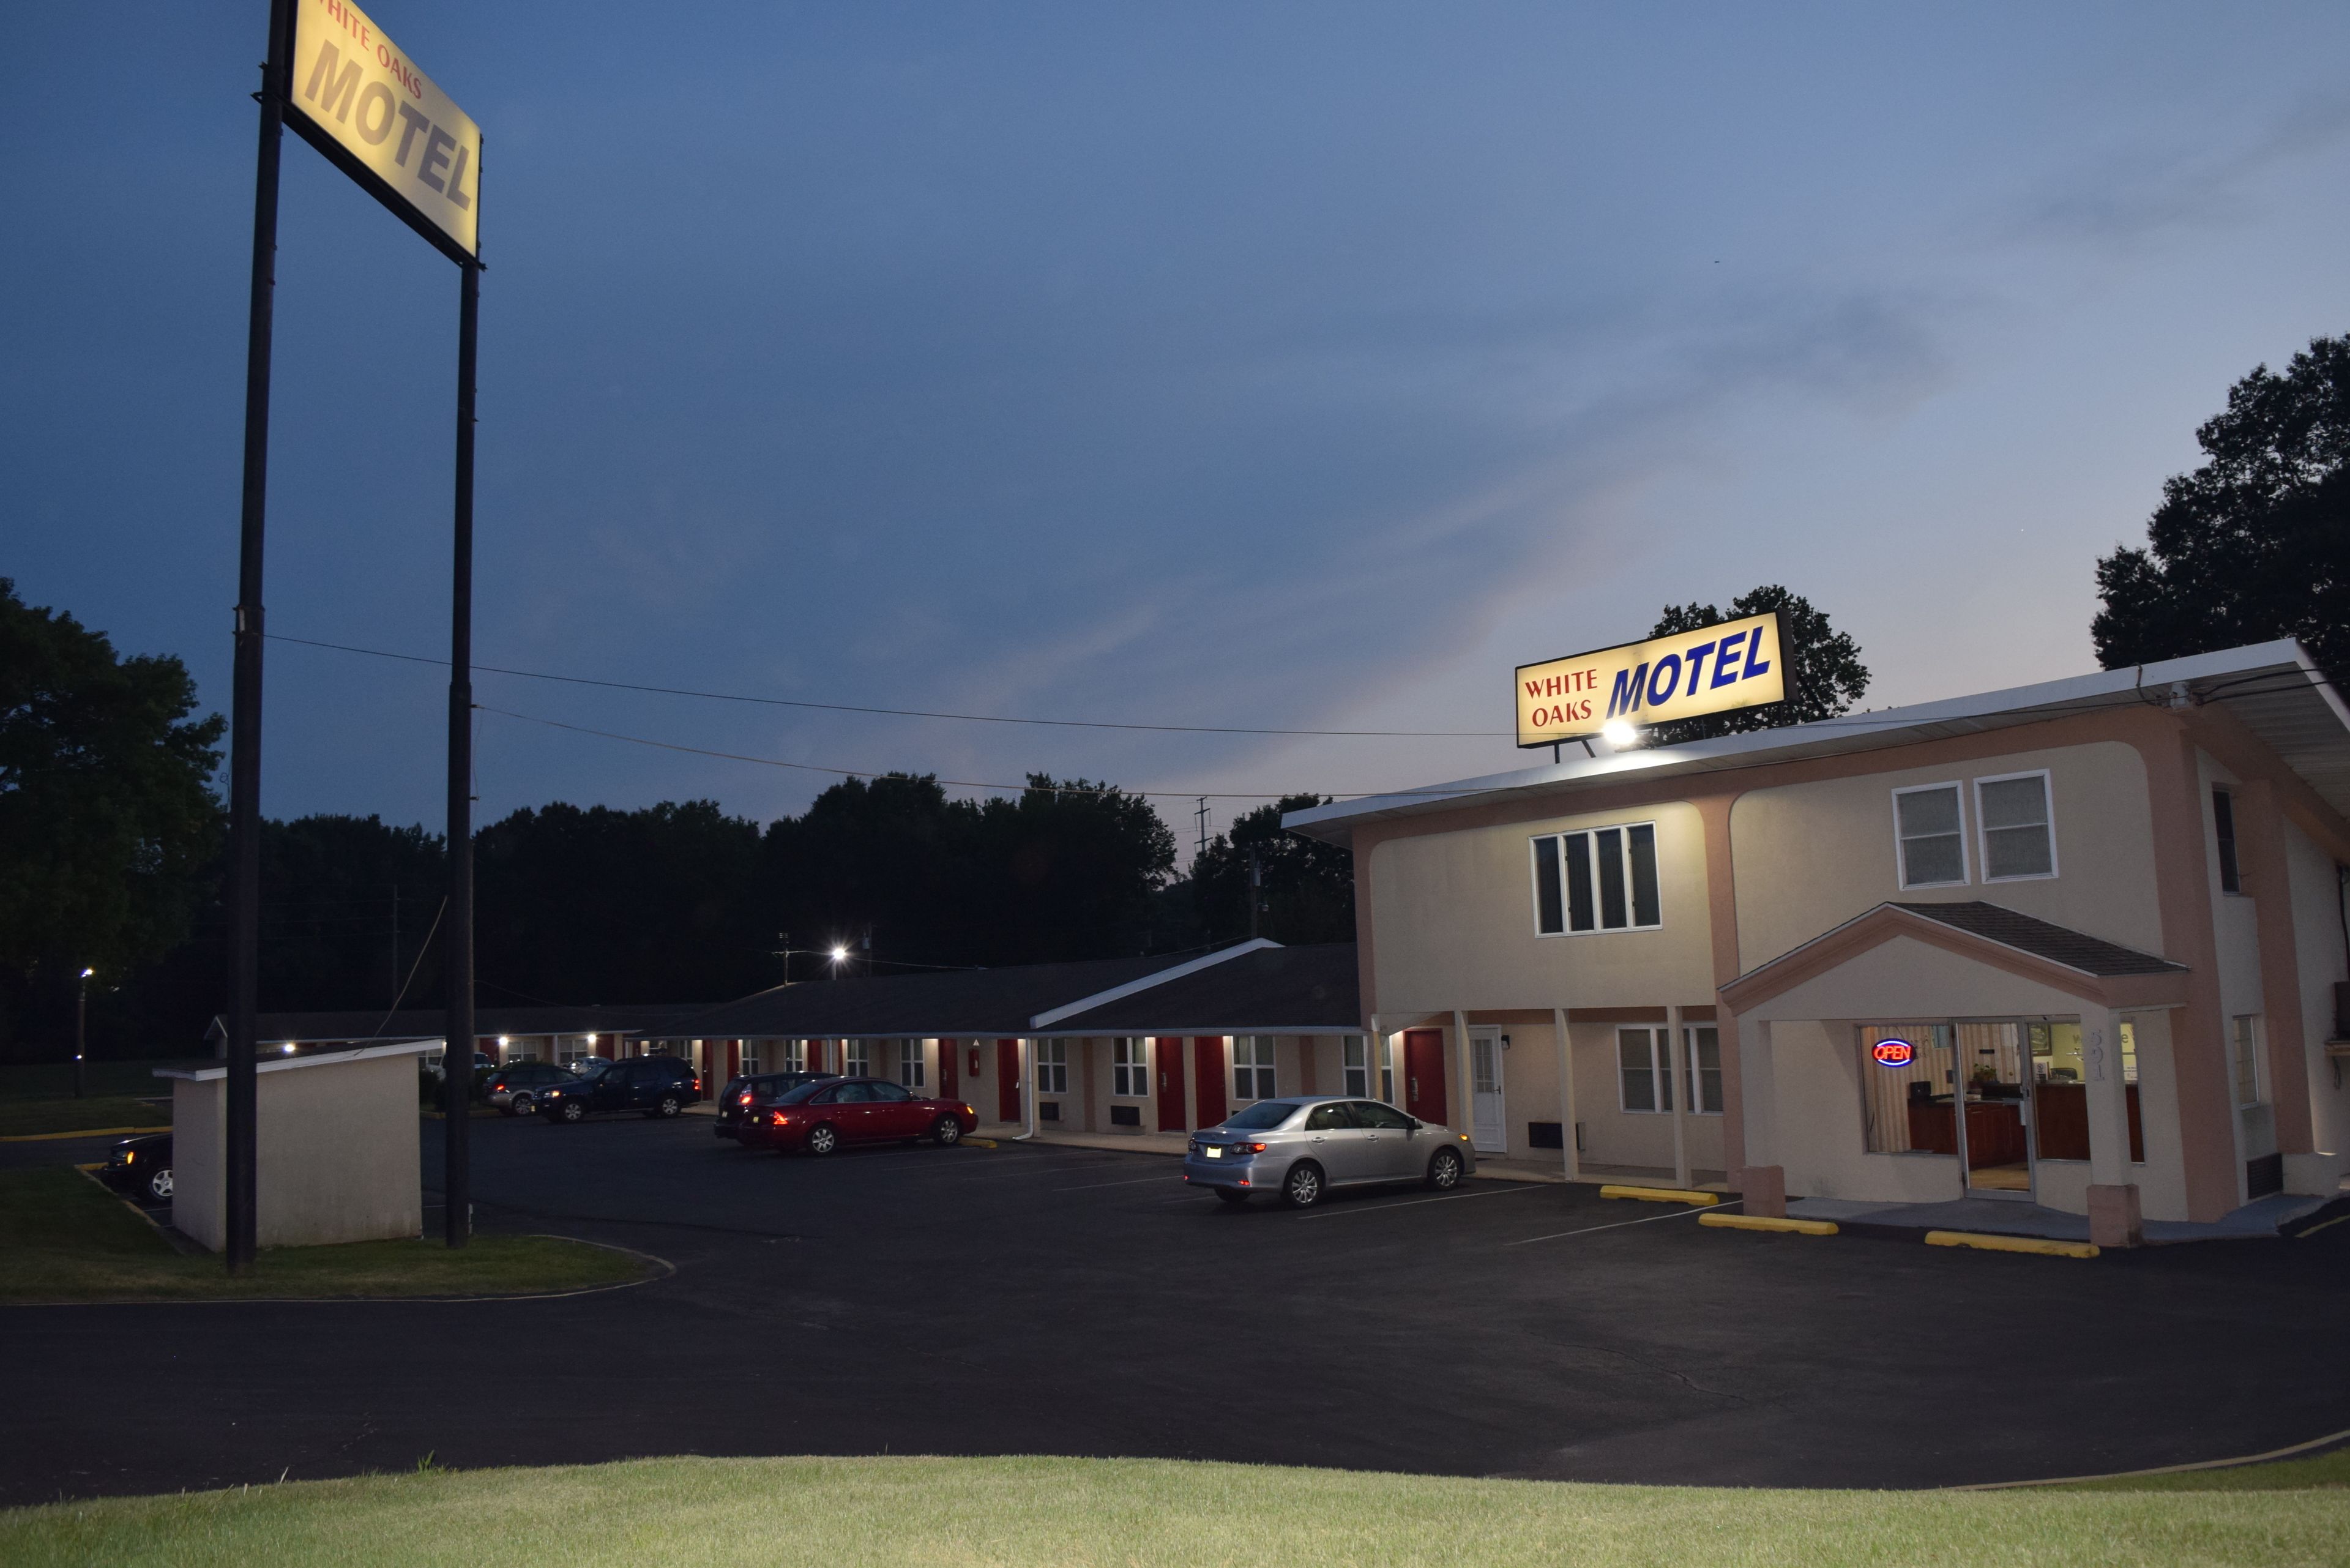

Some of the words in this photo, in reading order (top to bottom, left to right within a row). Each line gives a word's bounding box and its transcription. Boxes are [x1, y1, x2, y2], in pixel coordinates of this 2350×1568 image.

[319, 0, 370, 51] HITE
[377, 44, 422, 100] OAKS
[305, 39, 471, 212] MOTEL
[1525, 669, 1598, 699] WHITE
[1606, 625, 1771, 720] MOTEL
[1532, 700, 1592, 727] OAKS
[1873, 1045, 1911, 1059] OPEN
